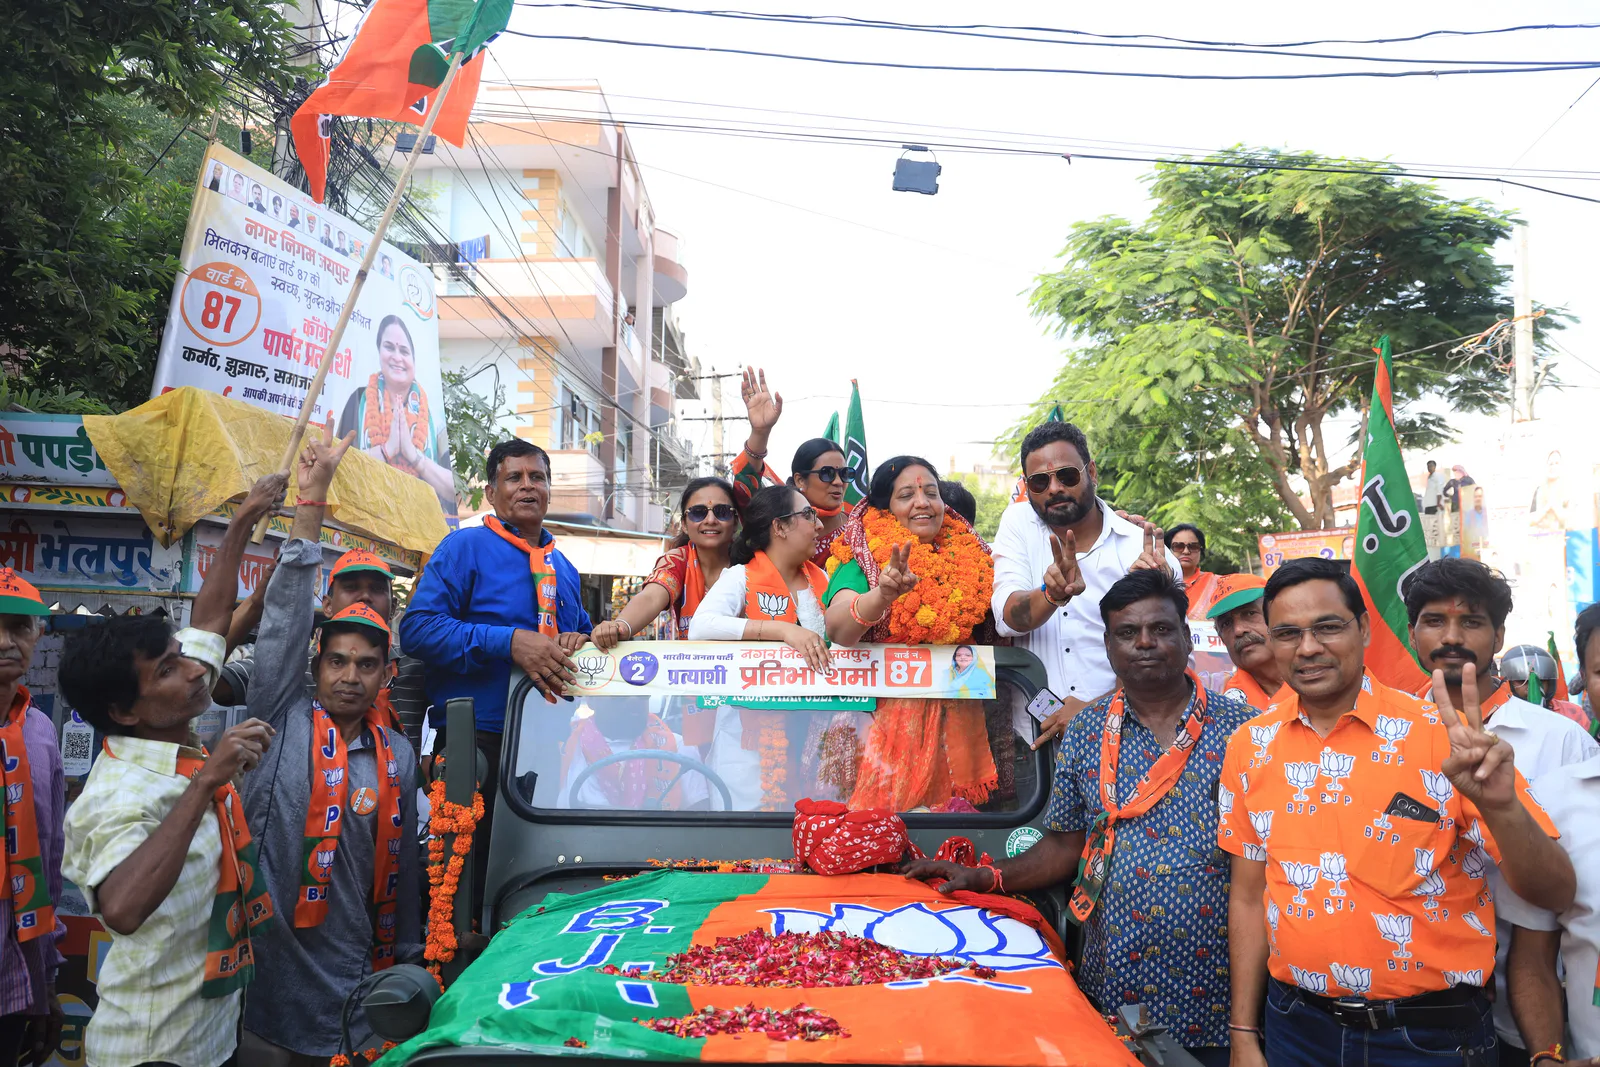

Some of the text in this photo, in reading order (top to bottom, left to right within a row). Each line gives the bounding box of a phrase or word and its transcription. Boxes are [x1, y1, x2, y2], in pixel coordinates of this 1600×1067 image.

[203, 227, 321, 289] मिलकर बनाएं वार्ड 87 को
[245, 216, 351, 286] नगर निगम जयपुर
[205, 267, 249, 291] वार्ड नं.
[200, 290, 243, 334] 87
[263, 327, 304, 363] पार्षद
[182, 344, 222, 372] कर्मठ,
[242, 386, 269, 402] आपकी
[267, 392, 288, 407] अपनी
[663, 652, 734, 662] भारतीय जनता पार्टी
[740, 648, 778, 660] नगर
[893, 650, 910, 660] वार्ड
[630, 662, 646, 681] 2
[667, 664, 729, 686] प्रत्याशी
[738, 659, 880, 691] प्रतिभा शर्मा
[889, 660, 928, 685] 87
[703, 699, 726, 707] RJC
[1371, 750, 1406, 766] BJP
[1286, 802, 1317, 815] BJP
[1364, 826, 1401, 846] BJP
[1286, 903, 1315, 920] BJP
[1386, 958, 1425, 972] BJP
